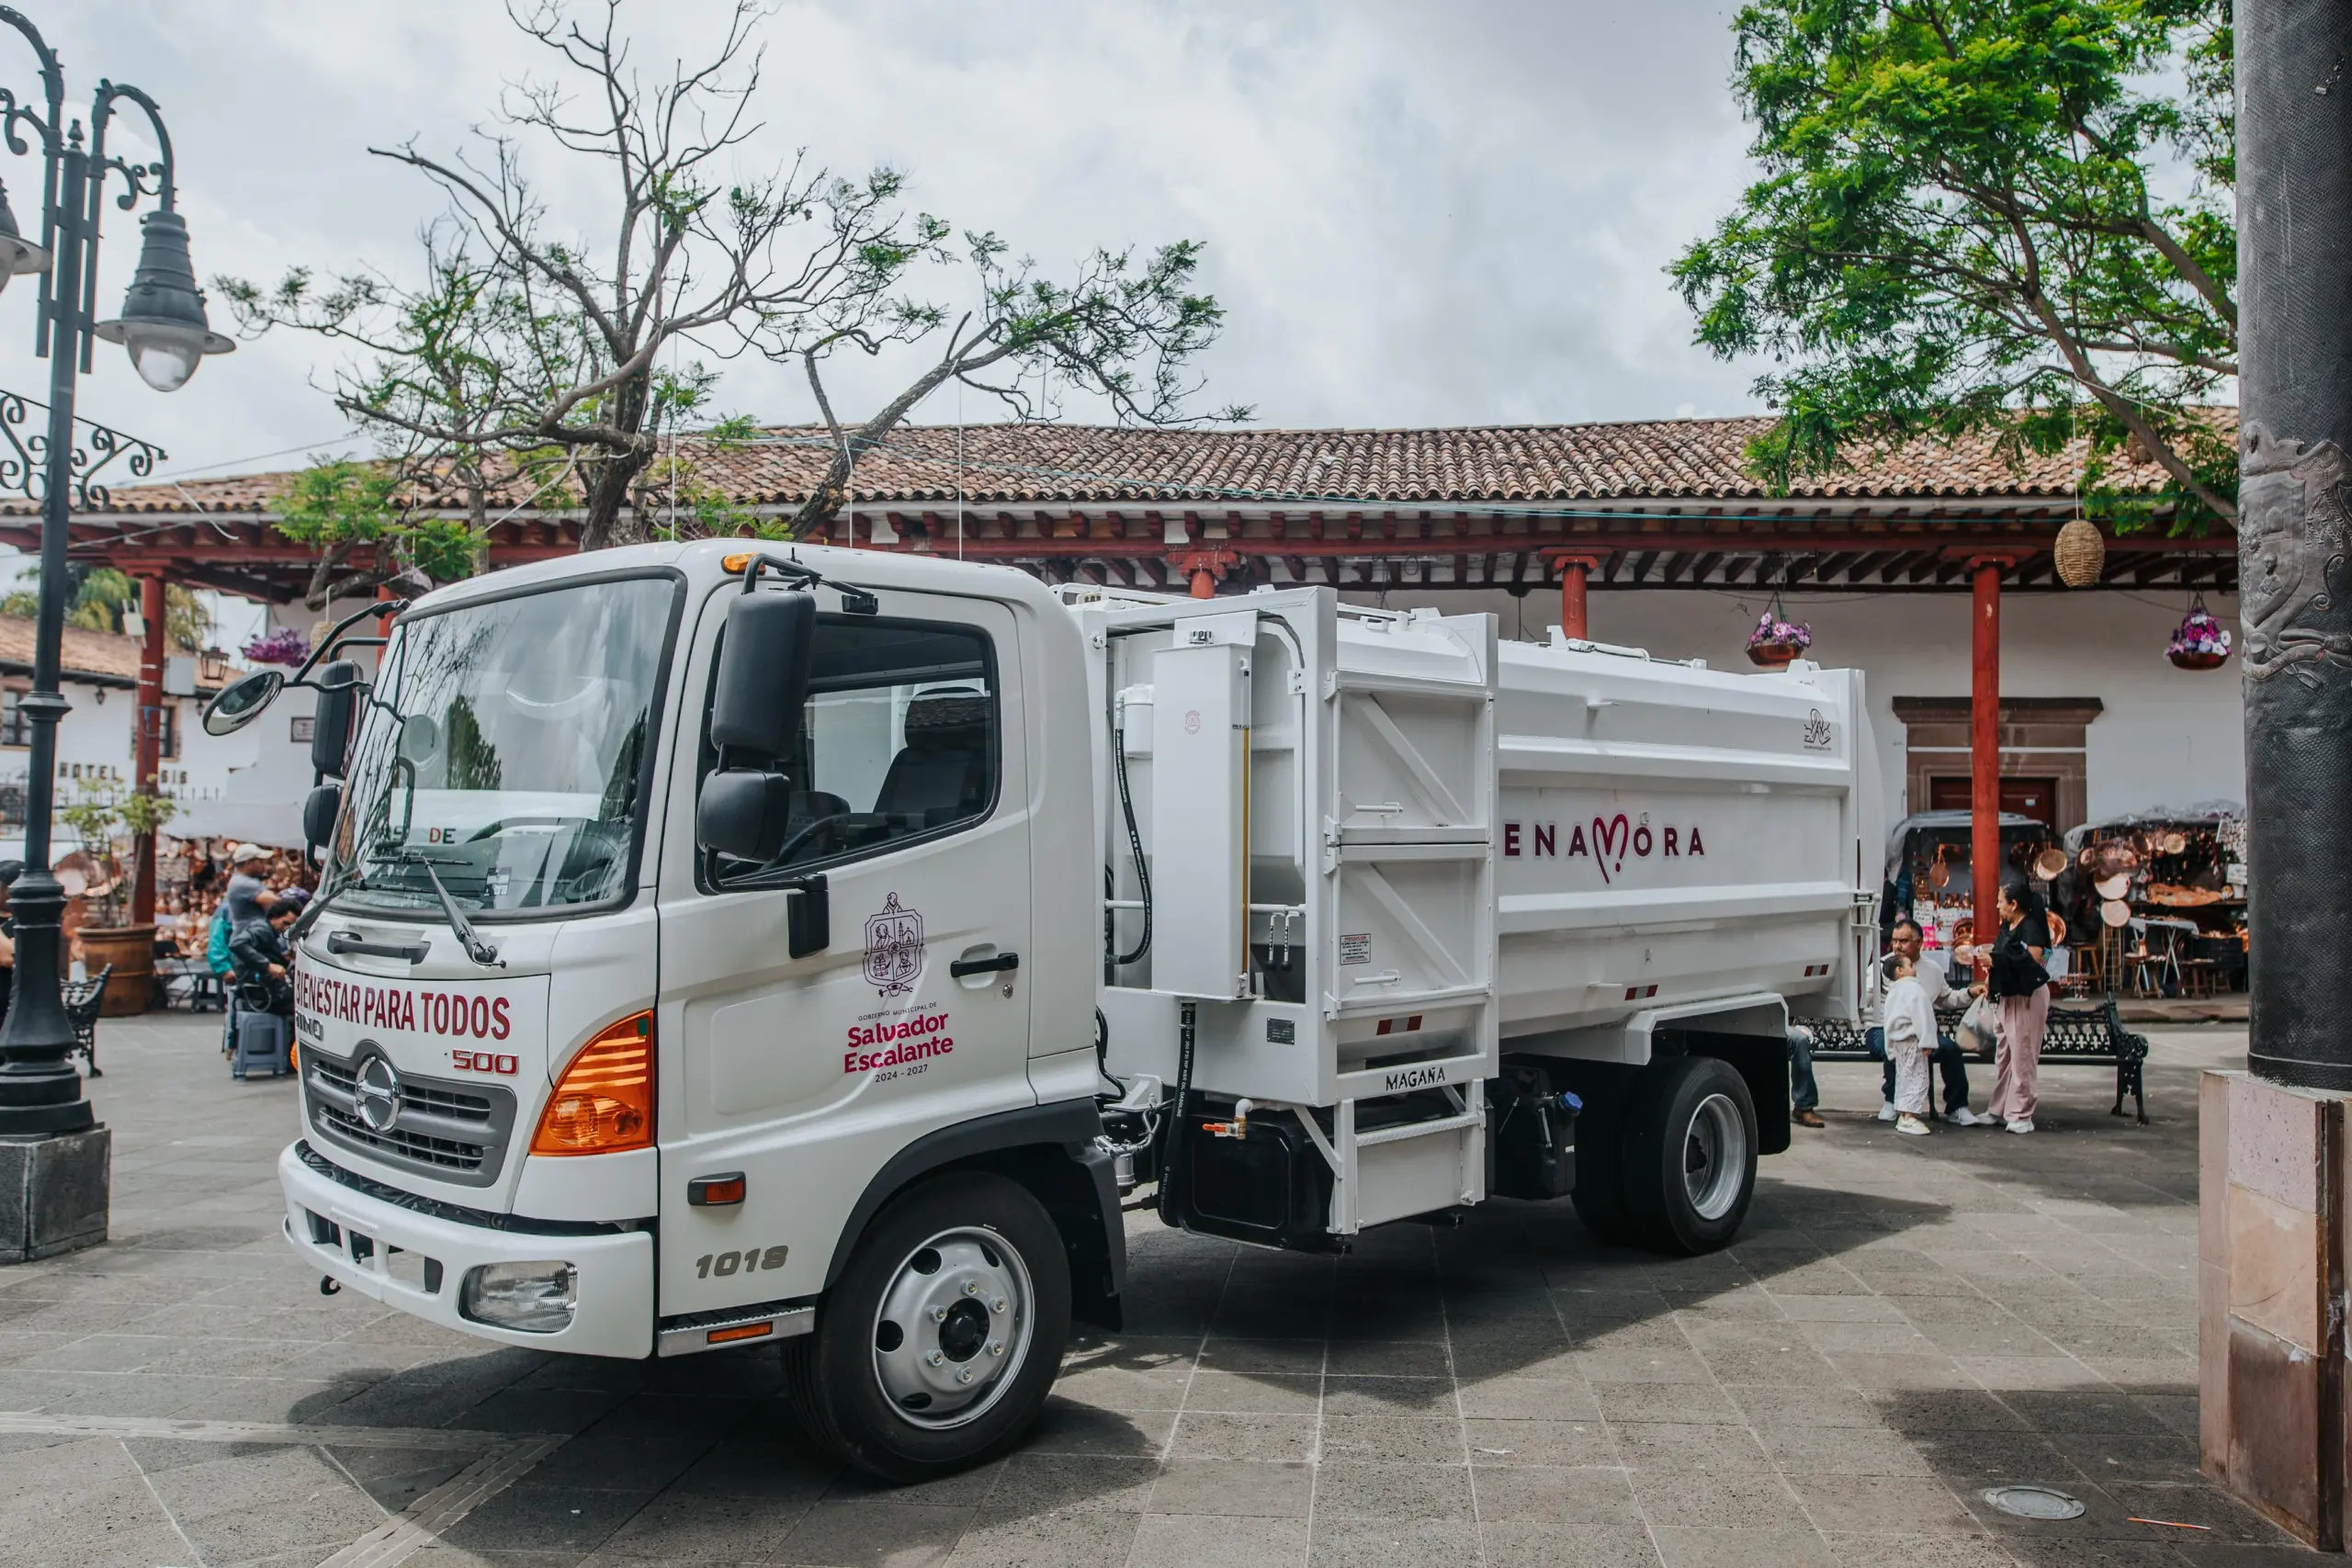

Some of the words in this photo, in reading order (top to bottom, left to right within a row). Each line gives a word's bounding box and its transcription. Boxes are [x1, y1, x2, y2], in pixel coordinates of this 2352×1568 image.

[60, 761, 119, 781] HOTEL
[1505, 814, 1704, 884] ENAMORA
[364, 987, 415, 1032] PARA
[421, 992, 511, 1041] TODOS
[857, 1010, 890, 1021] GOBIERNO
[892, 1004, 928, 1016] MUNICIPAL
[847, 1013, 949, 1048] Salvador
[452, 1048, 520, 1077] 500
[843, 1036, 954, 1074] Escalante
[875, 1071, 898, 1083] 2024
[906, 1064, 929, 1077] 2027
[1385, 1066, 1446, 1092] MAGAÑA
[695, 1245, 789, 1280] 1018
